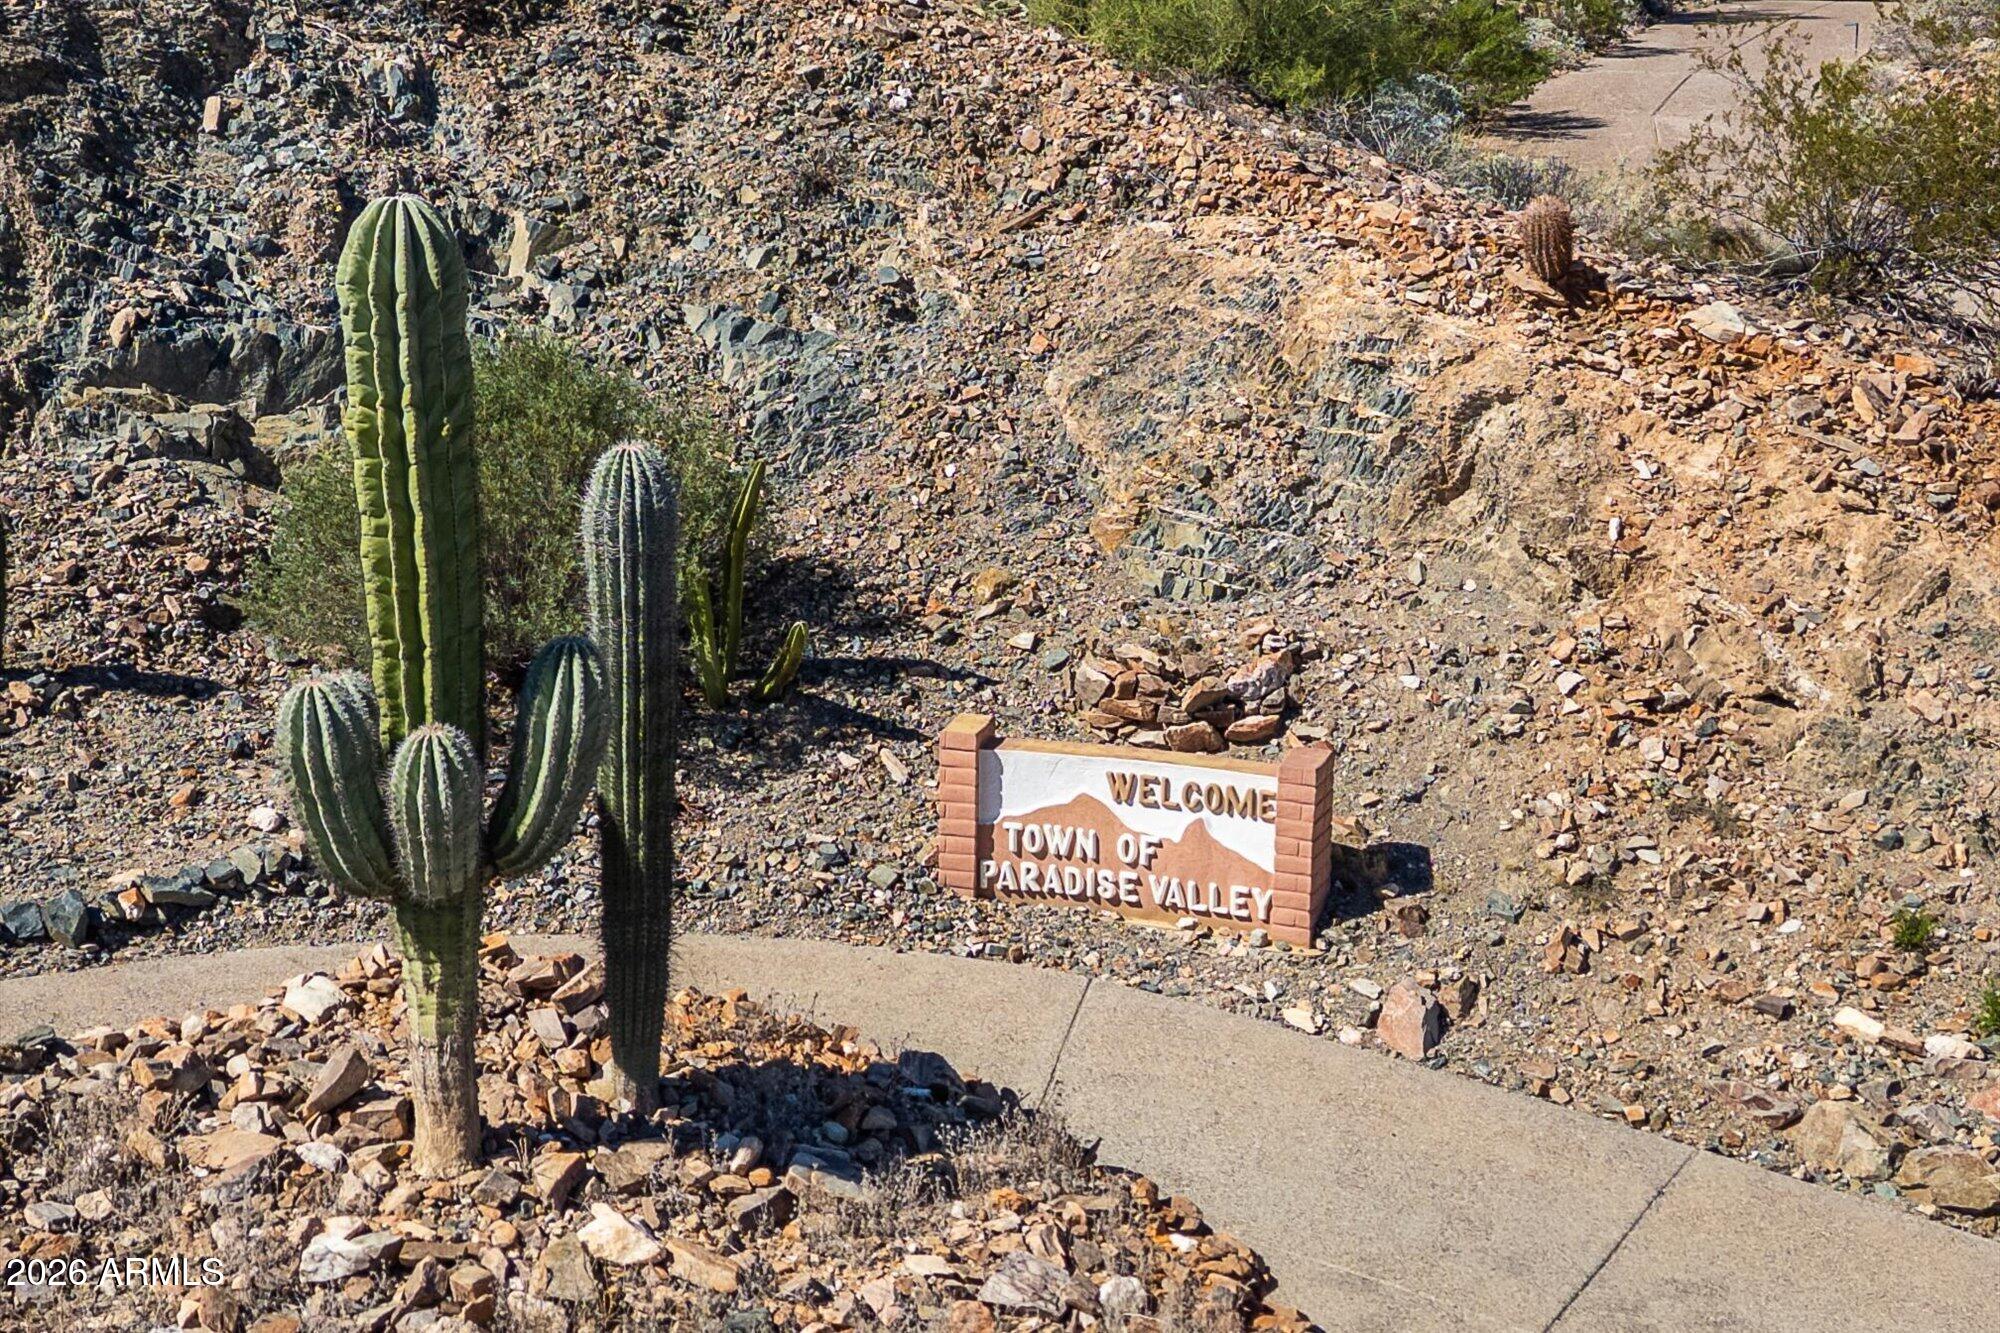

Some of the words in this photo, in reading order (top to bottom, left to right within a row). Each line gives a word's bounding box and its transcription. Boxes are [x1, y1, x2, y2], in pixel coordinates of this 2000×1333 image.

[1106, 771, 1276, 822] WELCOME
[1002, 821, 1099, 862] TOWN
[1116, 833, 1162, 868] OF
[980, 860, 1142, 905] PARADISE
[1149, 874, 1273, 922] VALLEY
